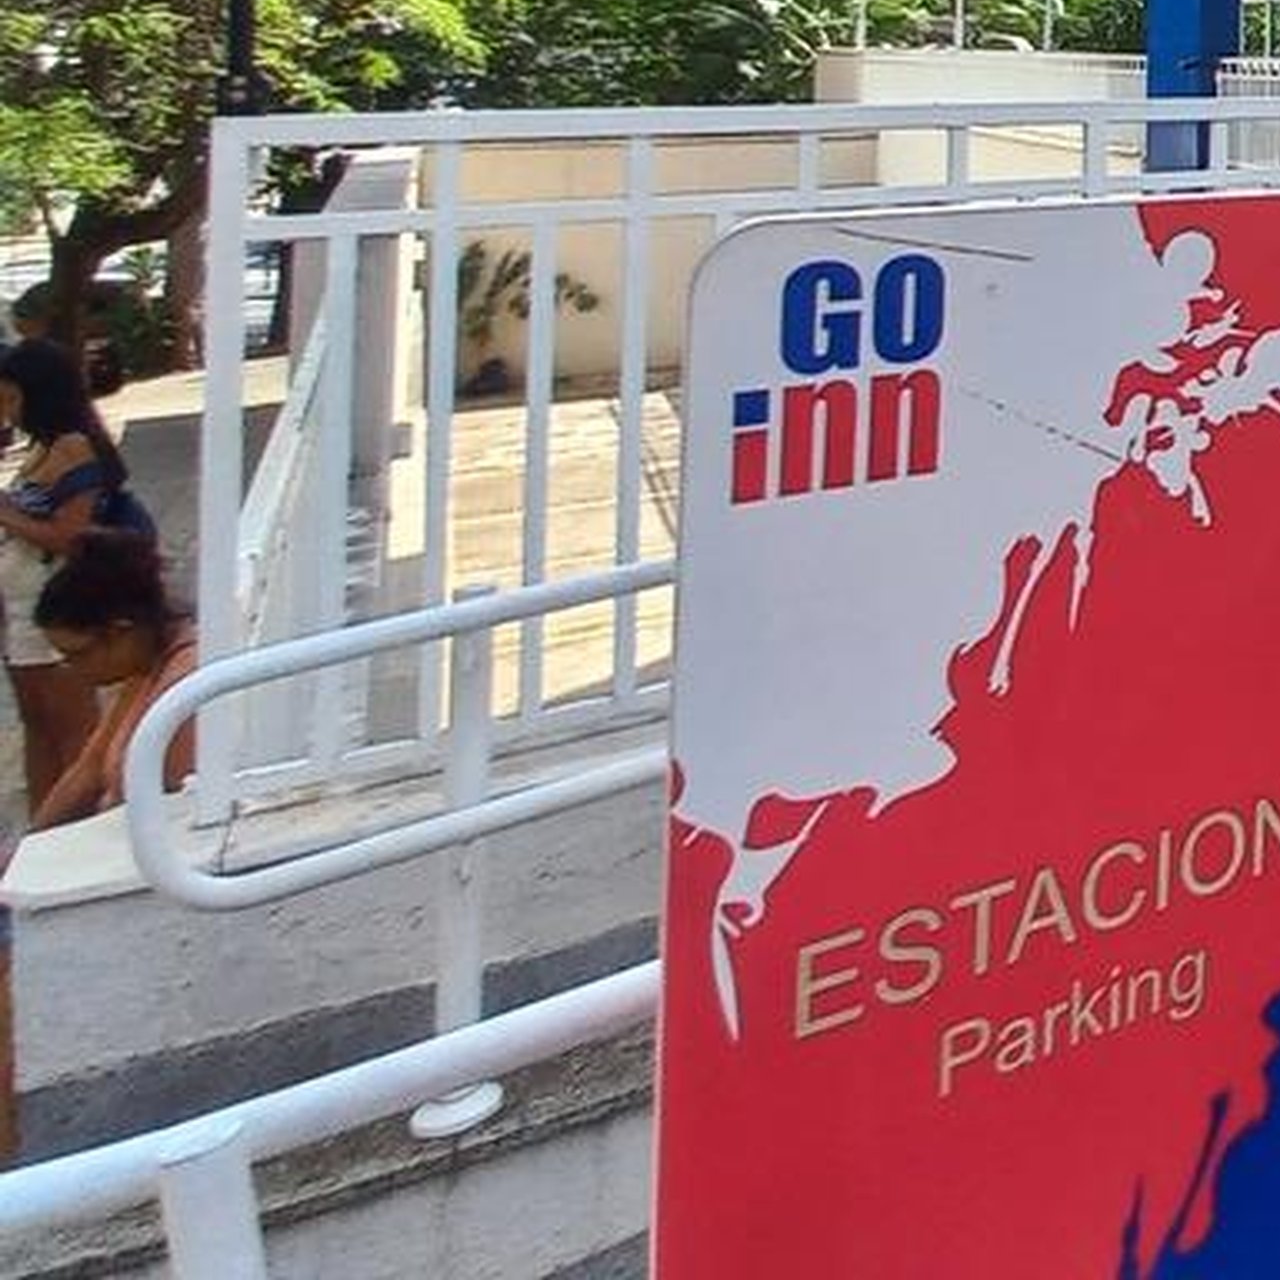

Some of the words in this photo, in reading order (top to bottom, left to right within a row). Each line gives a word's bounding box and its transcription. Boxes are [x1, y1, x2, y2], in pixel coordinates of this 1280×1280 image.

[778, 251, 946, 378] GO
[733, 367, 941, 504] inn
[937, 950, 1207, 1098] Parking
